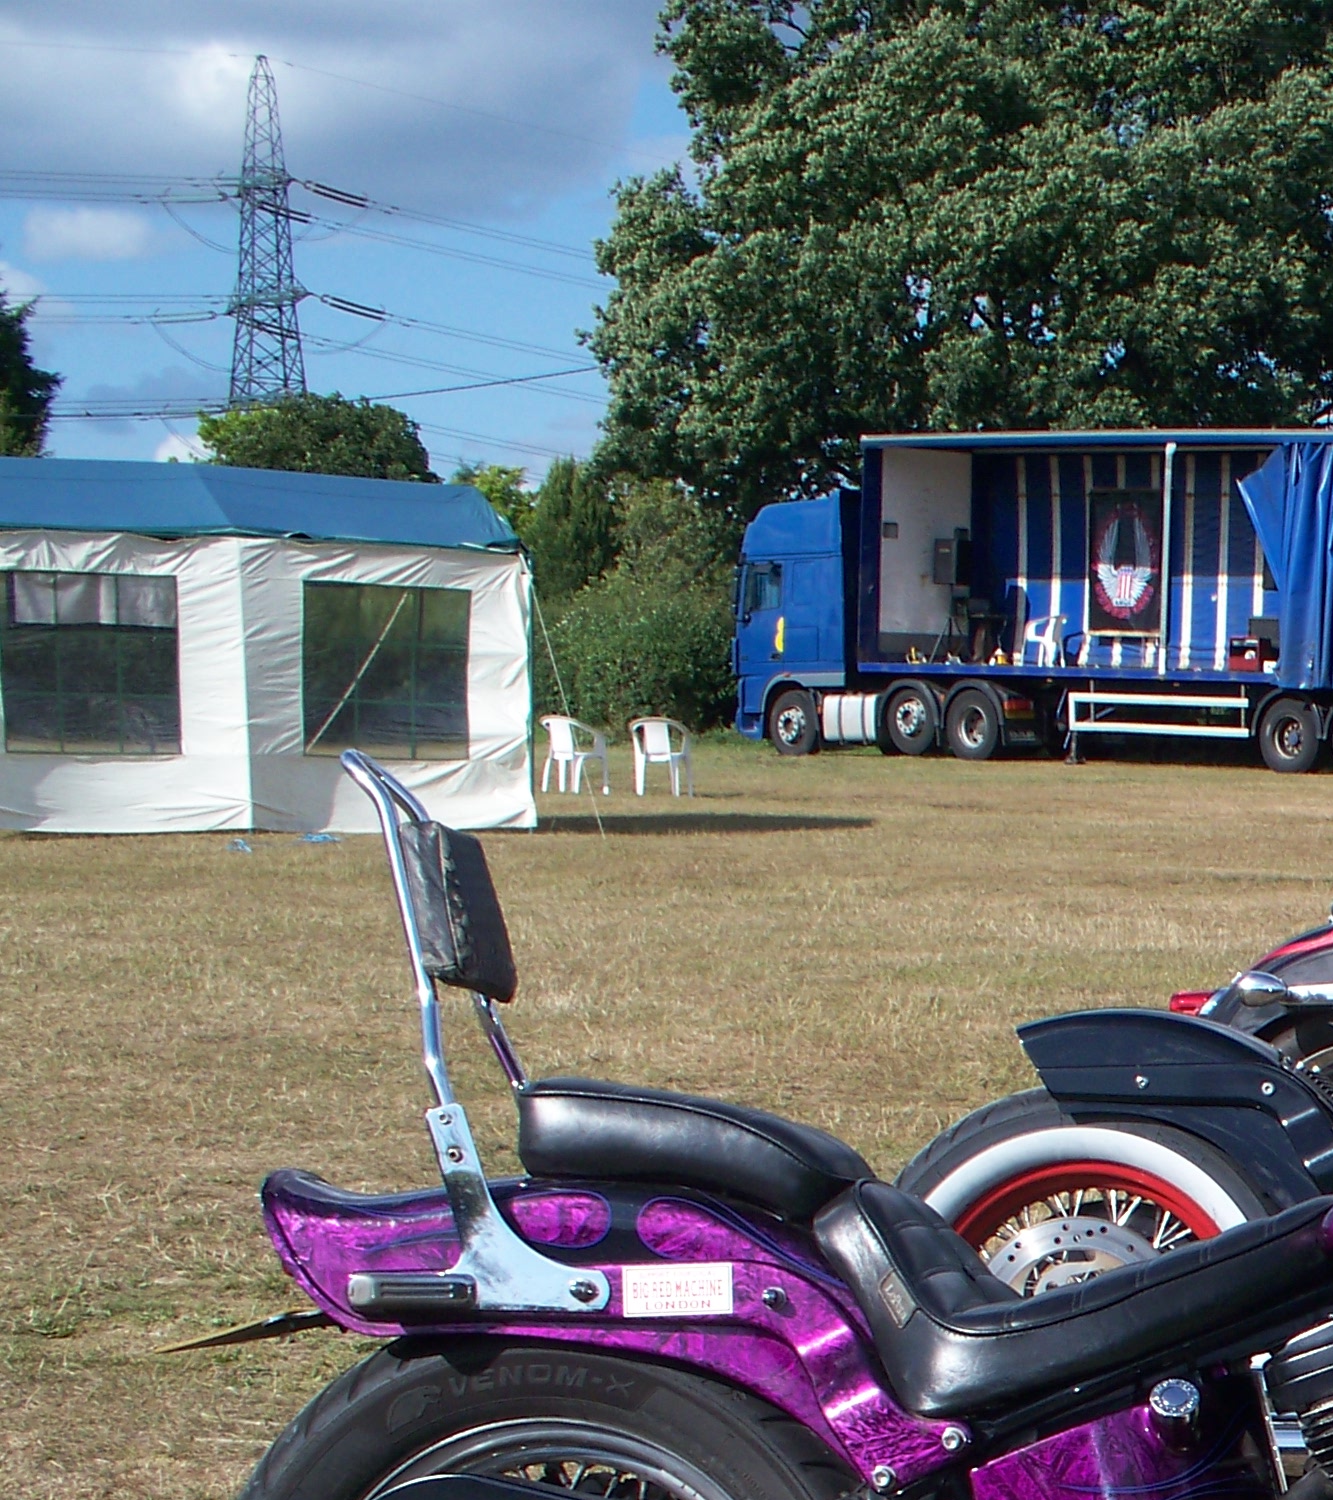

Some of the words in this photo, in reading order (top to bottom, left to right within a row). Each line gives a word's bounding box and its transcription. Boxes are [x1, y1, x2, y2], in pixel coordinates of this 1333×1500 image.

[632, 1281, 649, 1299] BIG
[652, 1280, 672, 1298] RED
[675, 1279, 723, 1297] MACHINE
[645, 1299, 711, 1311] LONDON
[449, 1364, 635, 1398] VENOM-X
